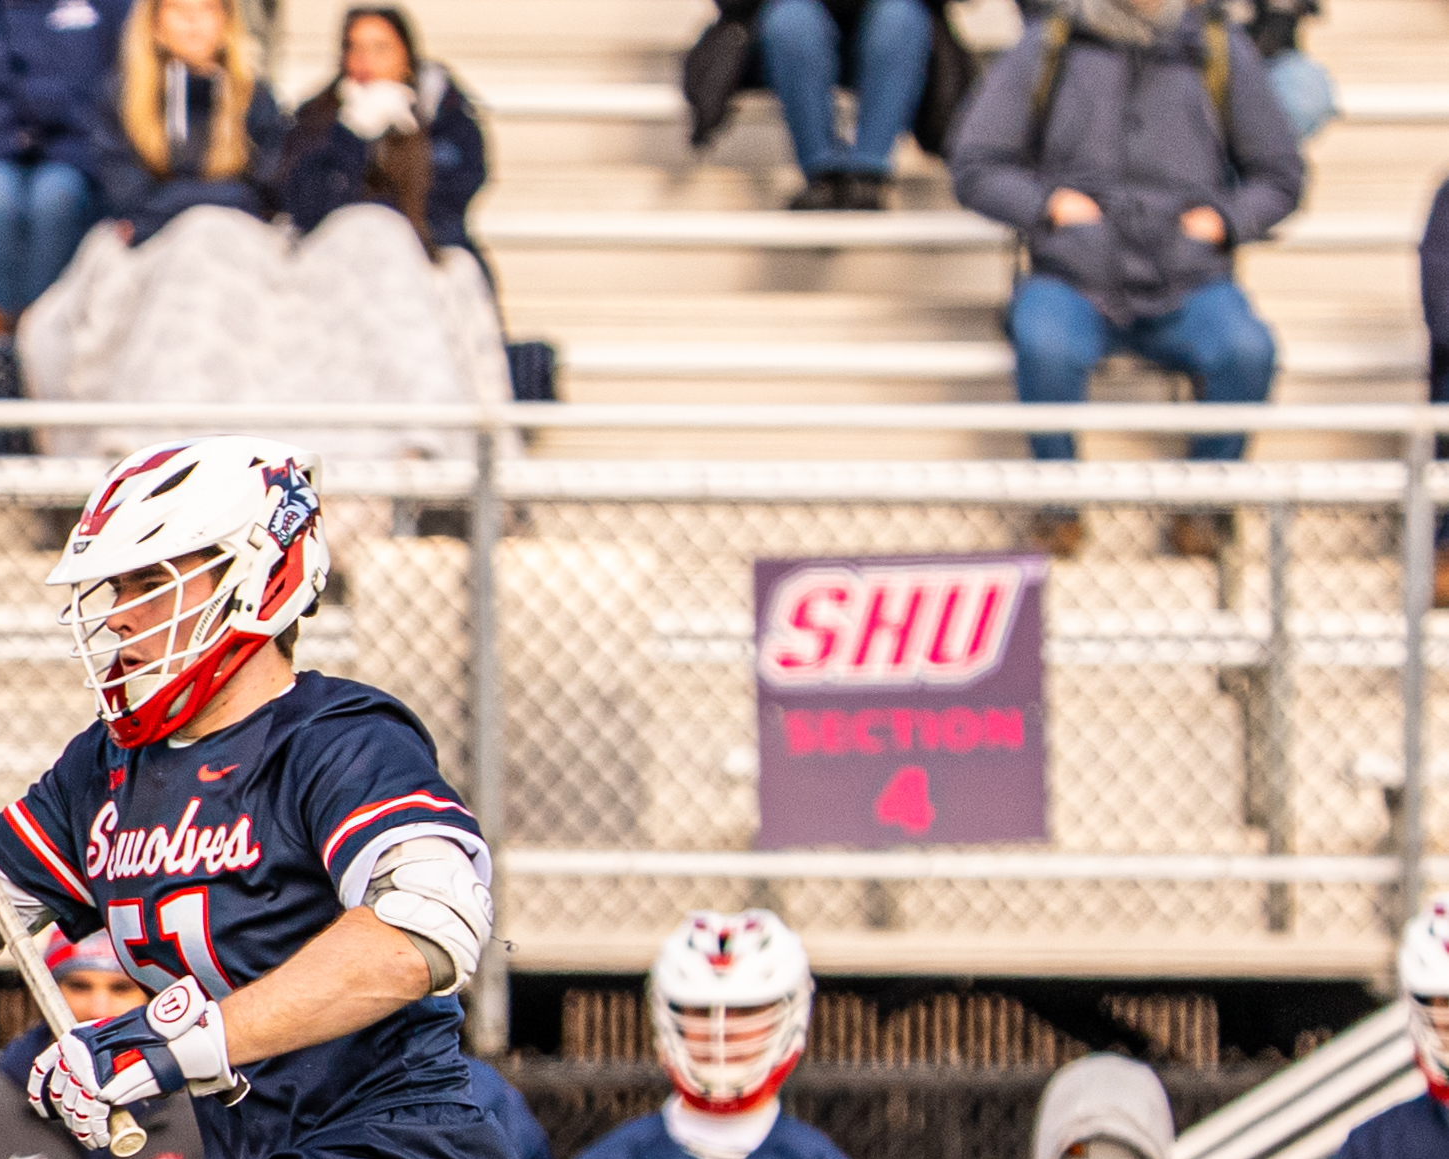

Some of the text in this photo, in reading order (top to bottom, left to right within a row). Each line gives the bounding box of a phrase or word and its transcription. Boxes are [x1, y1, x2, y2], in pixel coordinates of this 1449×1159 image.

[762, 568, 1015, 681] SHU
[781, 706, 1024, 757] SECTION
[872, 764, 937, 836] 4
[107, 886, 237, 1003] 51
